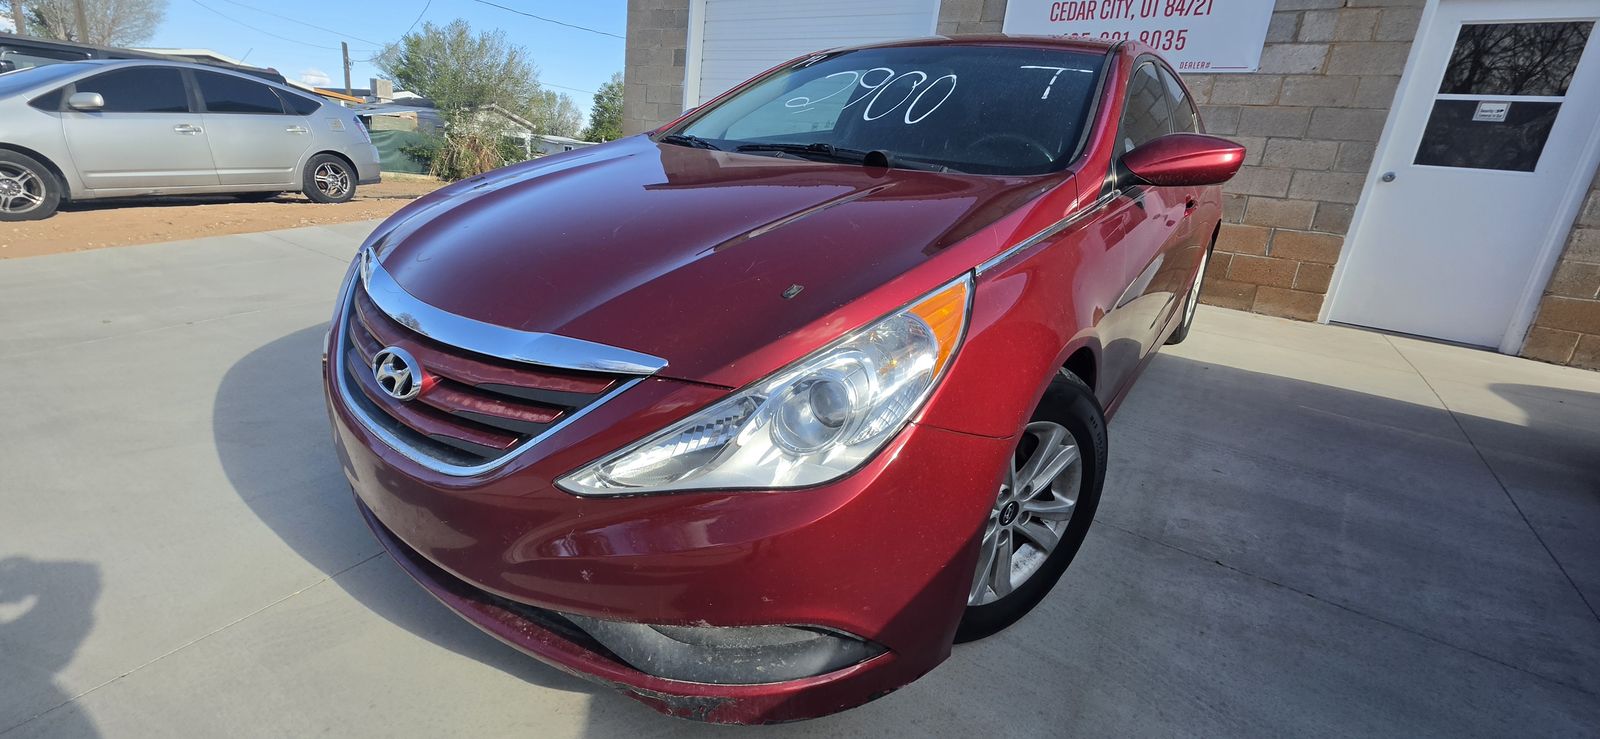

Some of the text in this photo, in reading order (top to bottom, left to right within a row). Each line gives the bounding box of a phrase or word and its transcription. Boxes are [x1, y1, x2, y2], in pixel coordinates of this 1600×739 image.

[1050, 1, 1097, 22] CEDAR
[1100, 0, 1135, 20] CITY,
[785, 67, 957, 124] 2900
[1020, 65, 1094, 100] T
